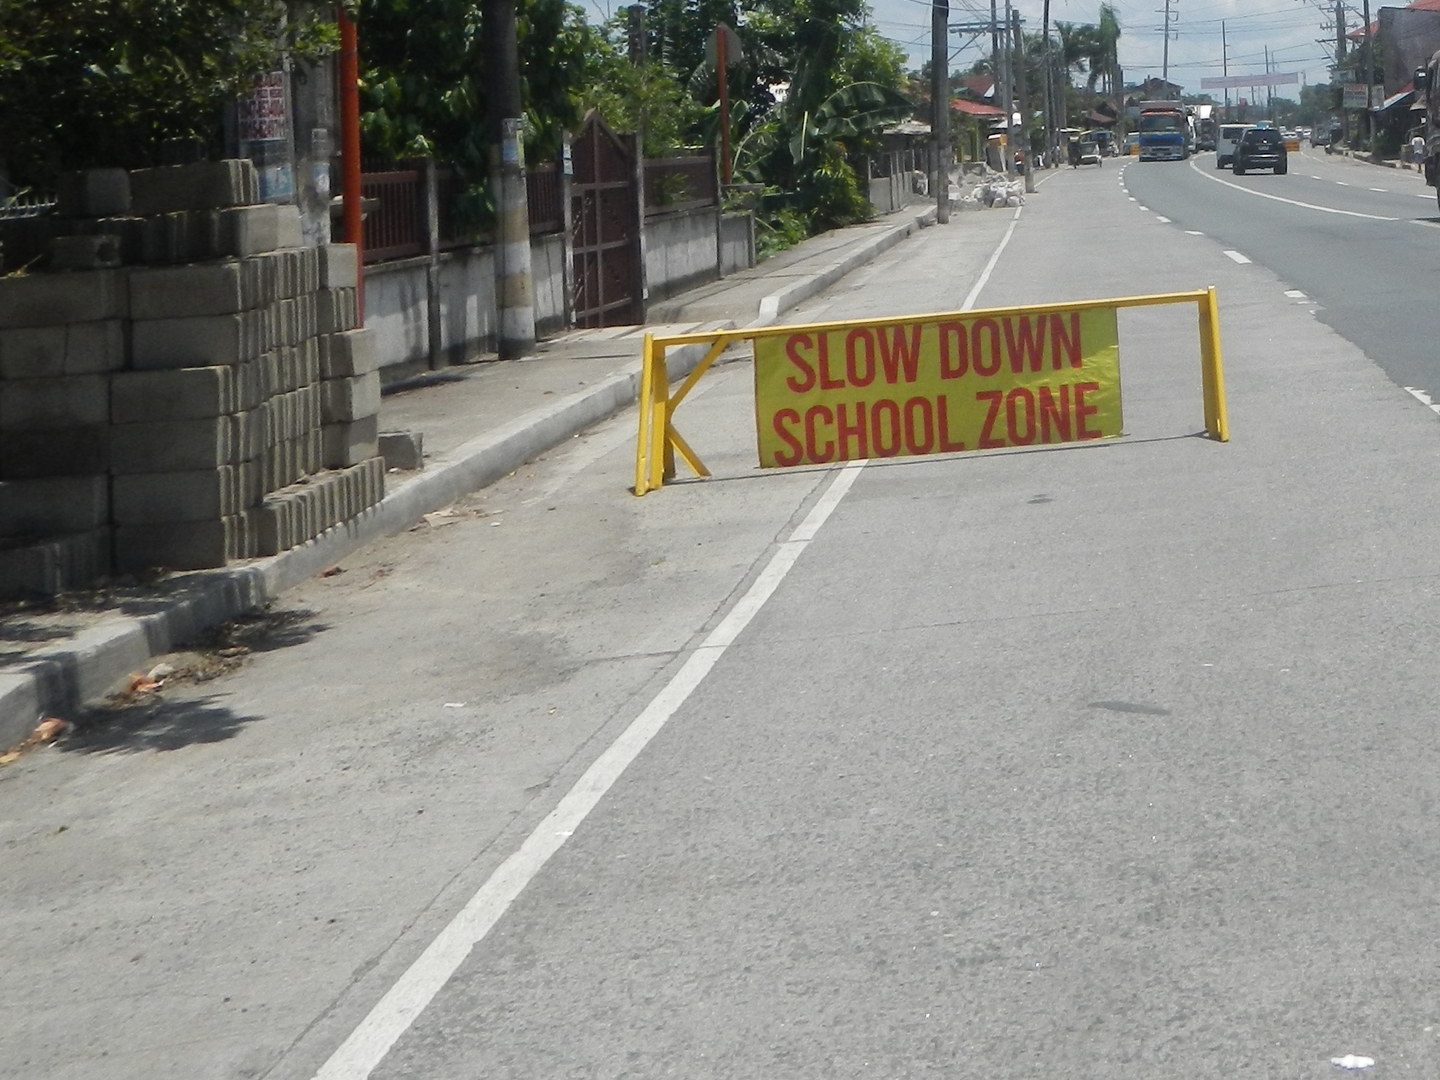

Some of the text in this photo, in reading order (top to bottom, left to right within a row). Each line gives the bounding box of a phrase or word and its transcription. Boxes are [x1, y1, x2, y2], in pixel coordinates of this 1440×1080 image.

[785, 311, 1083, 394] SLOW DOWN
[772, 381, 1103, 468] SCHOOL ZONE
